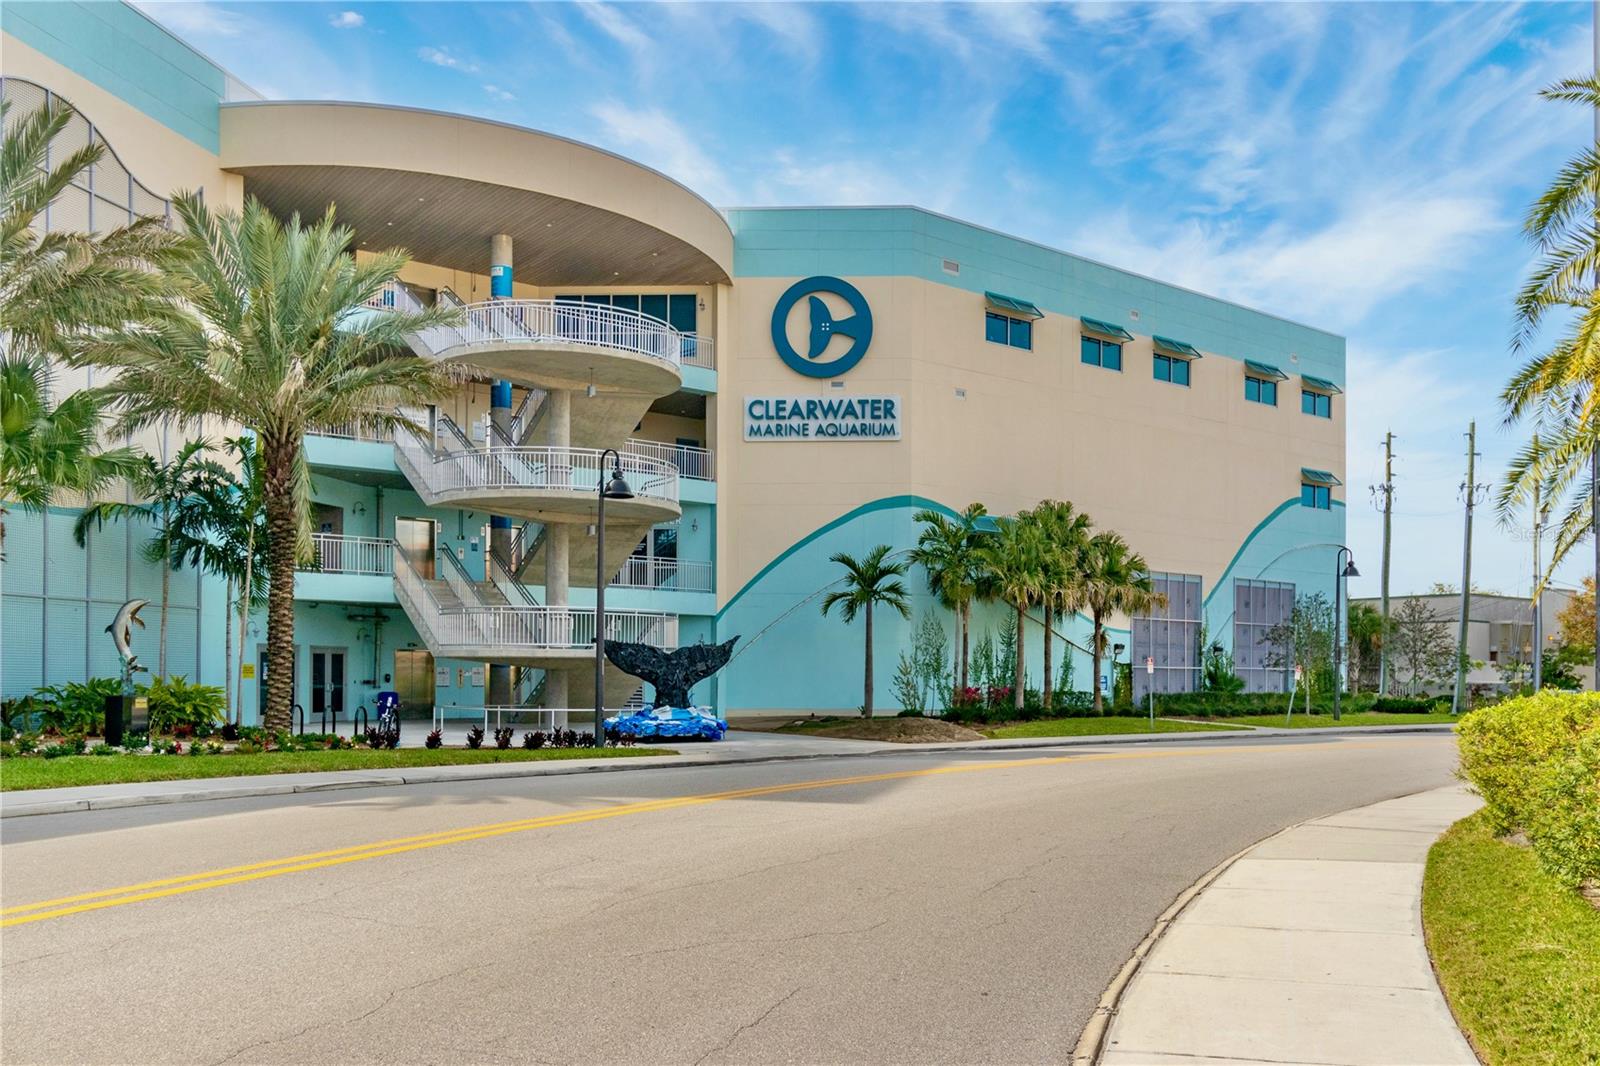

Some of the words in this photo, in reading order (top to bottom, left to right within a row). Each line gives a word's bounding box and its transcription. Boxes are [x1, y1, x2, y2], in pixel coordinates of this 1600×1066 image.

[748, 399, 896, 421] CLEARWATER
[749, 423, 810, 438] MARINE
[815, 423, 896, 438] AQUARIUM
